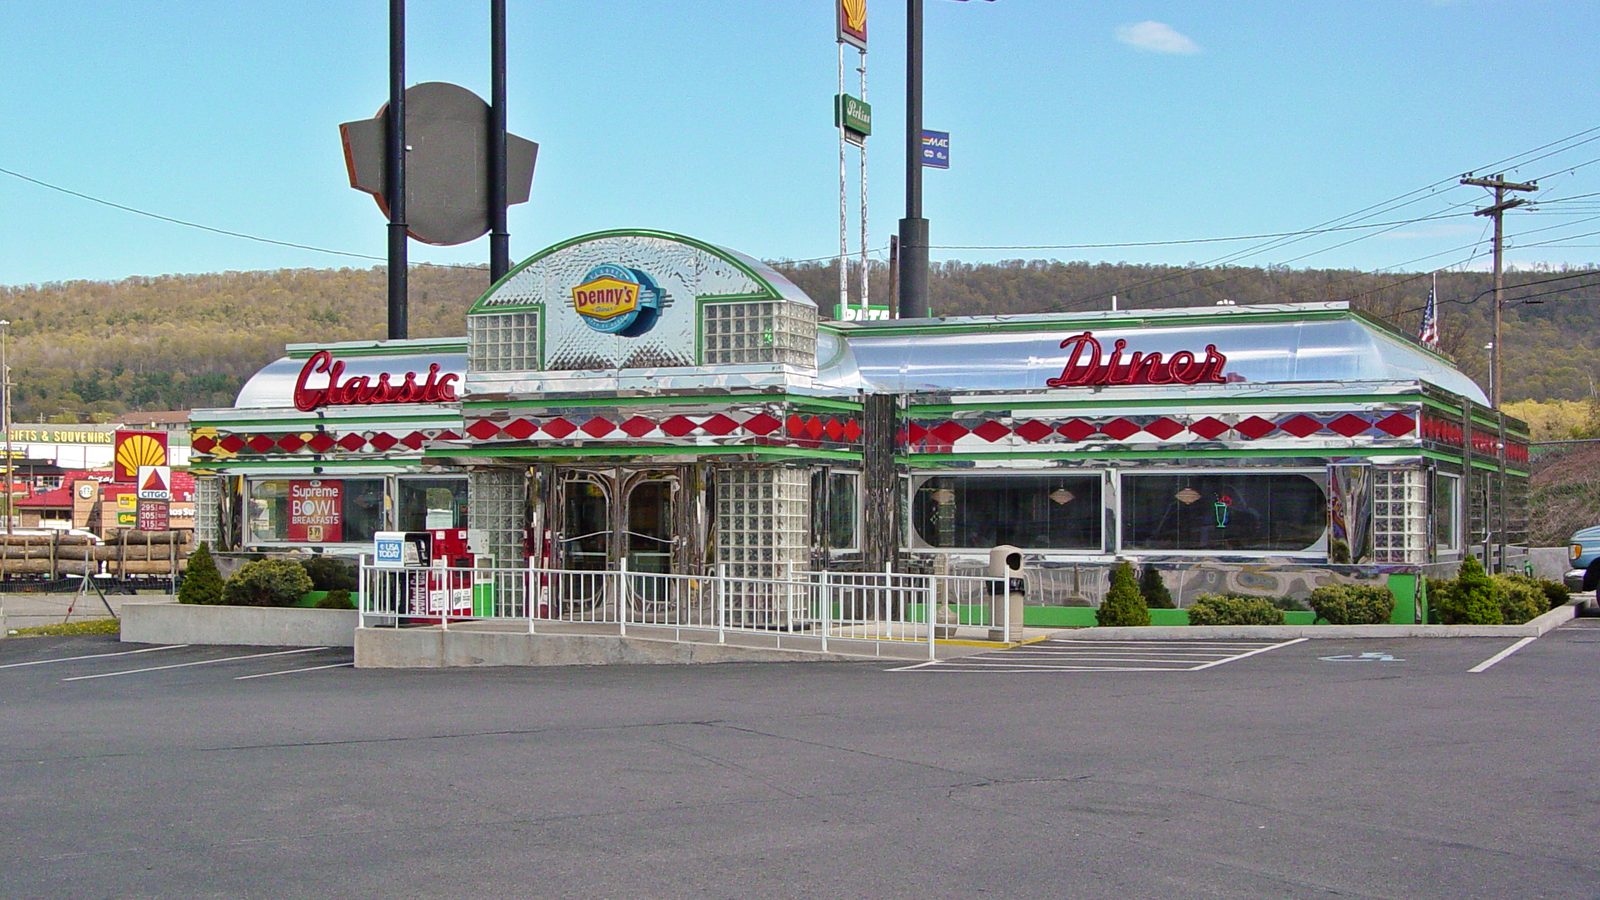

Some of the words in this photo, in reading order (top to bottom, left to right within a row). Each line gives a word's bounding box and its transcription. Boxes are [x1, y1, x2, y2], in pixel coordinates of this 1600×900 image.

[847, 100, 871, 124] Perkins
[927, 137, 949, 148] MAC
[576, 286, 633, 307] Denny's
[1046, 331, 1226, 386] Diner
[293, 350, 460, 412] Classic
[10, 430, 37, 441] GIFTS
[41, 430, 49, 442] &
[54, 431, 111, 443] SOUVENIRS
[292, 485, 339, 500] Supreme
[292, 500, 339, 516] BOWL
[292, 516, 339, 525] BREAKFASTS
[378, 550, 400, 558] TODAY
[385, 543, 400, 551] USA
